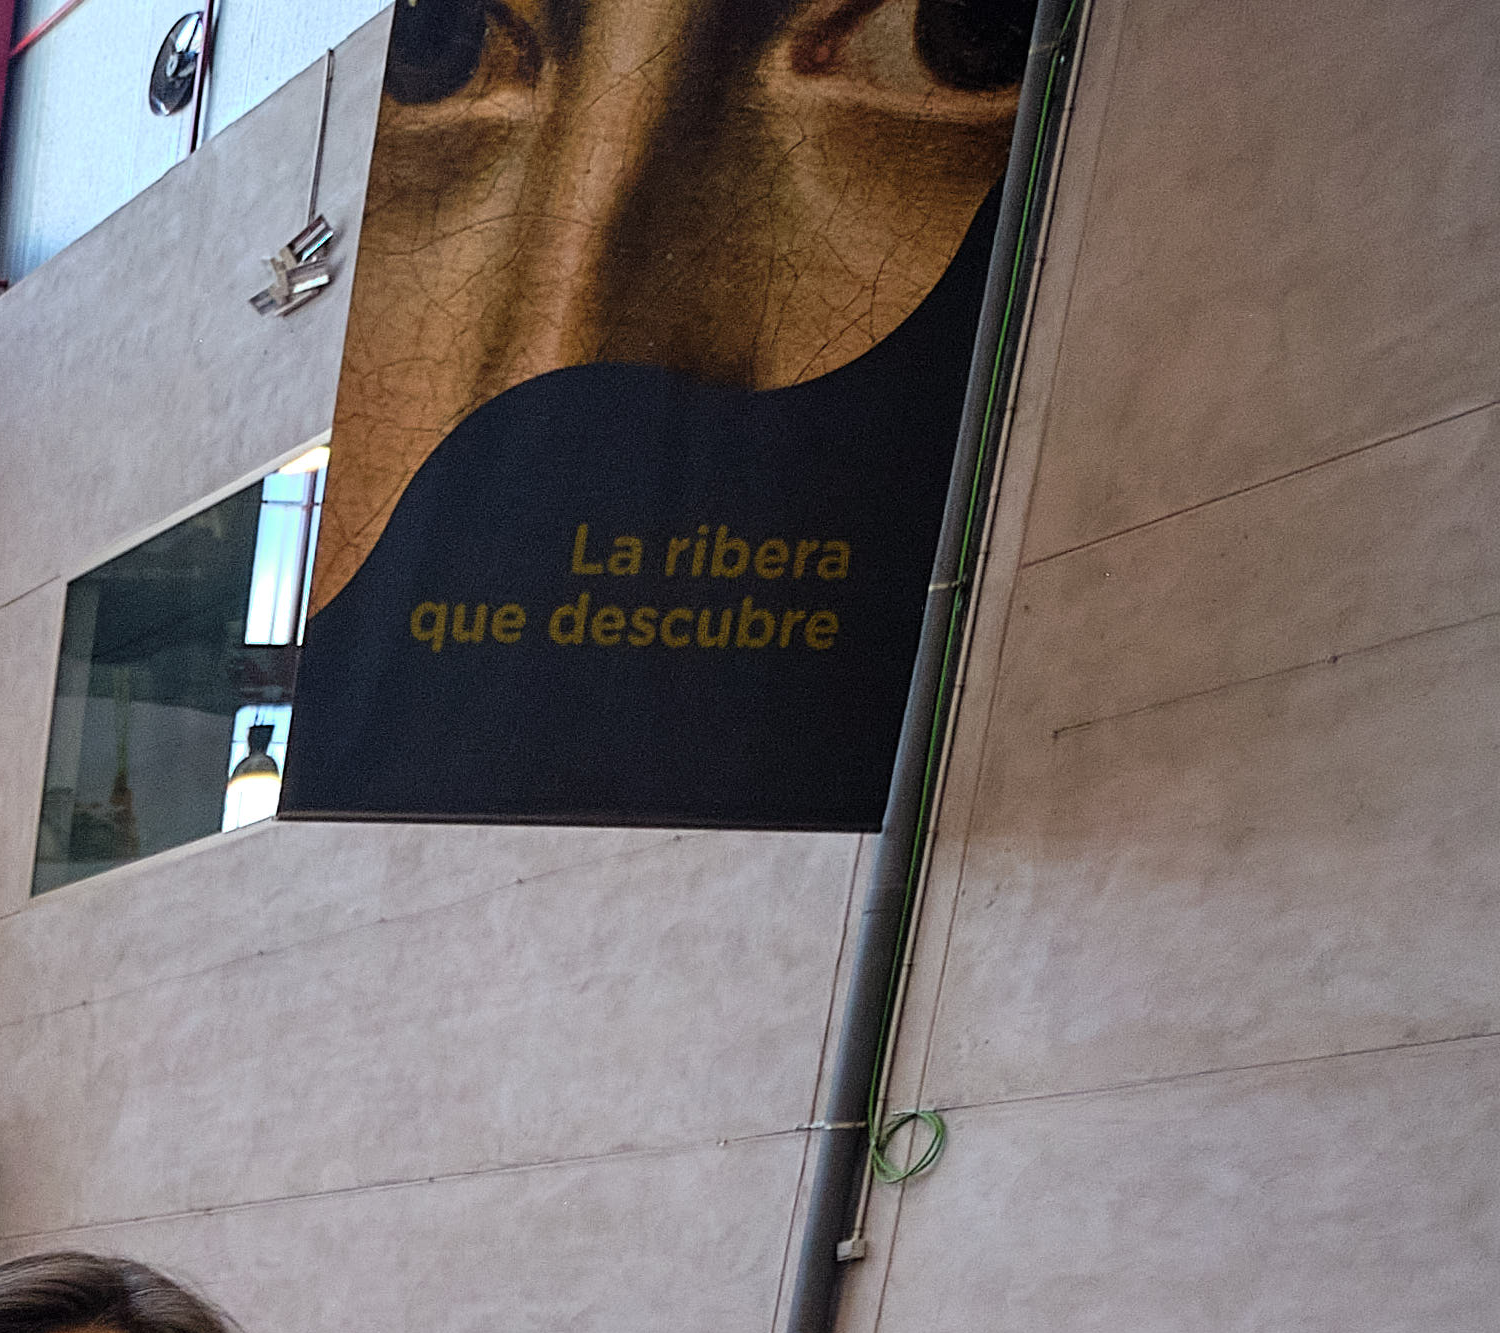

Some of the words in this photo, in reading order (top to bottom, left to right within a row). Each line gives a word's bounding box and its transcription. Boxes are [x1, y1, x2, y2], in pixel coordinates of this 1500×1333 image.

[572, 523, 642, 576] La
[664, 523, 851, 579] ribera
[409, 600, 526, 654] que
[548, 594, 841, 651] descubre
